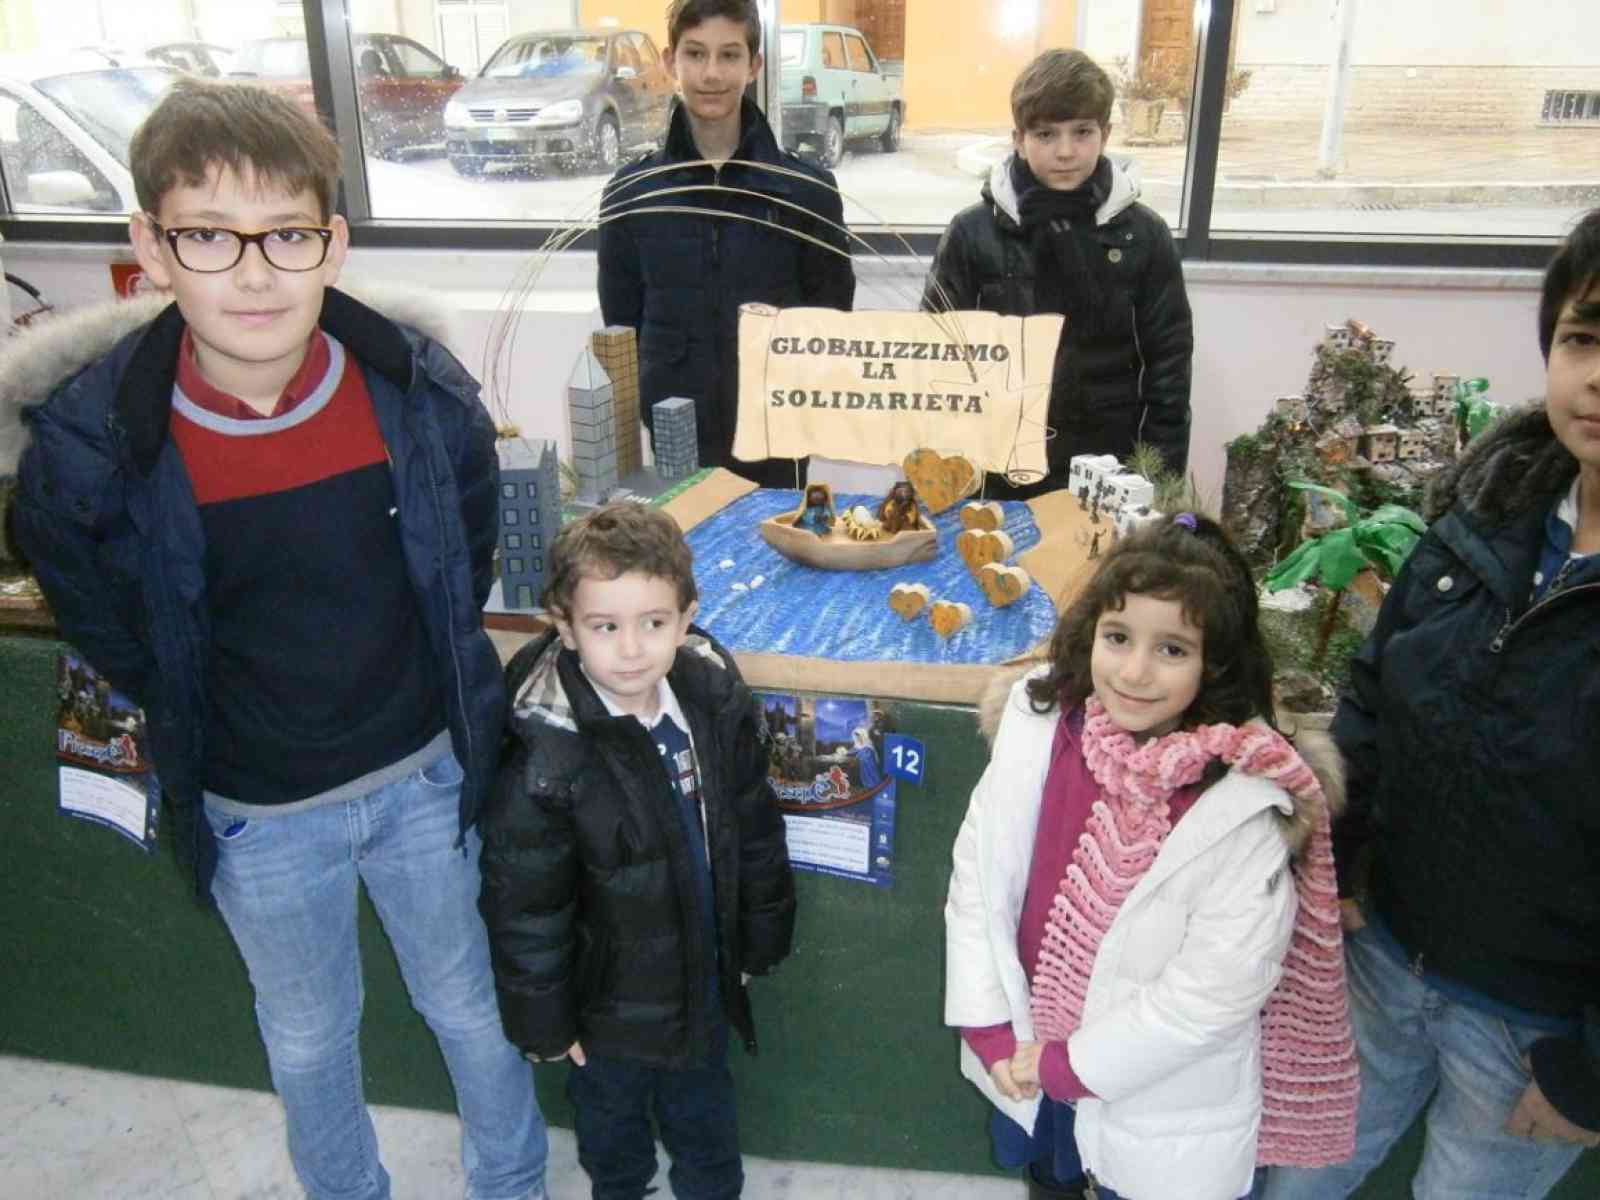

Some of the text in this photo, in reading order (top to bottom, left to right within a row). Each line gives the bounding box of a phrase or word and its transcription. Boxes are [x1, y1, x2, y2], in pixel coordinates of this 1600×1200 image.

[770, 337, 1009, 361] GLOBALIZZIAMO
[862, 362, 896, 379] LA
[892, 745, 919, 775] 12
